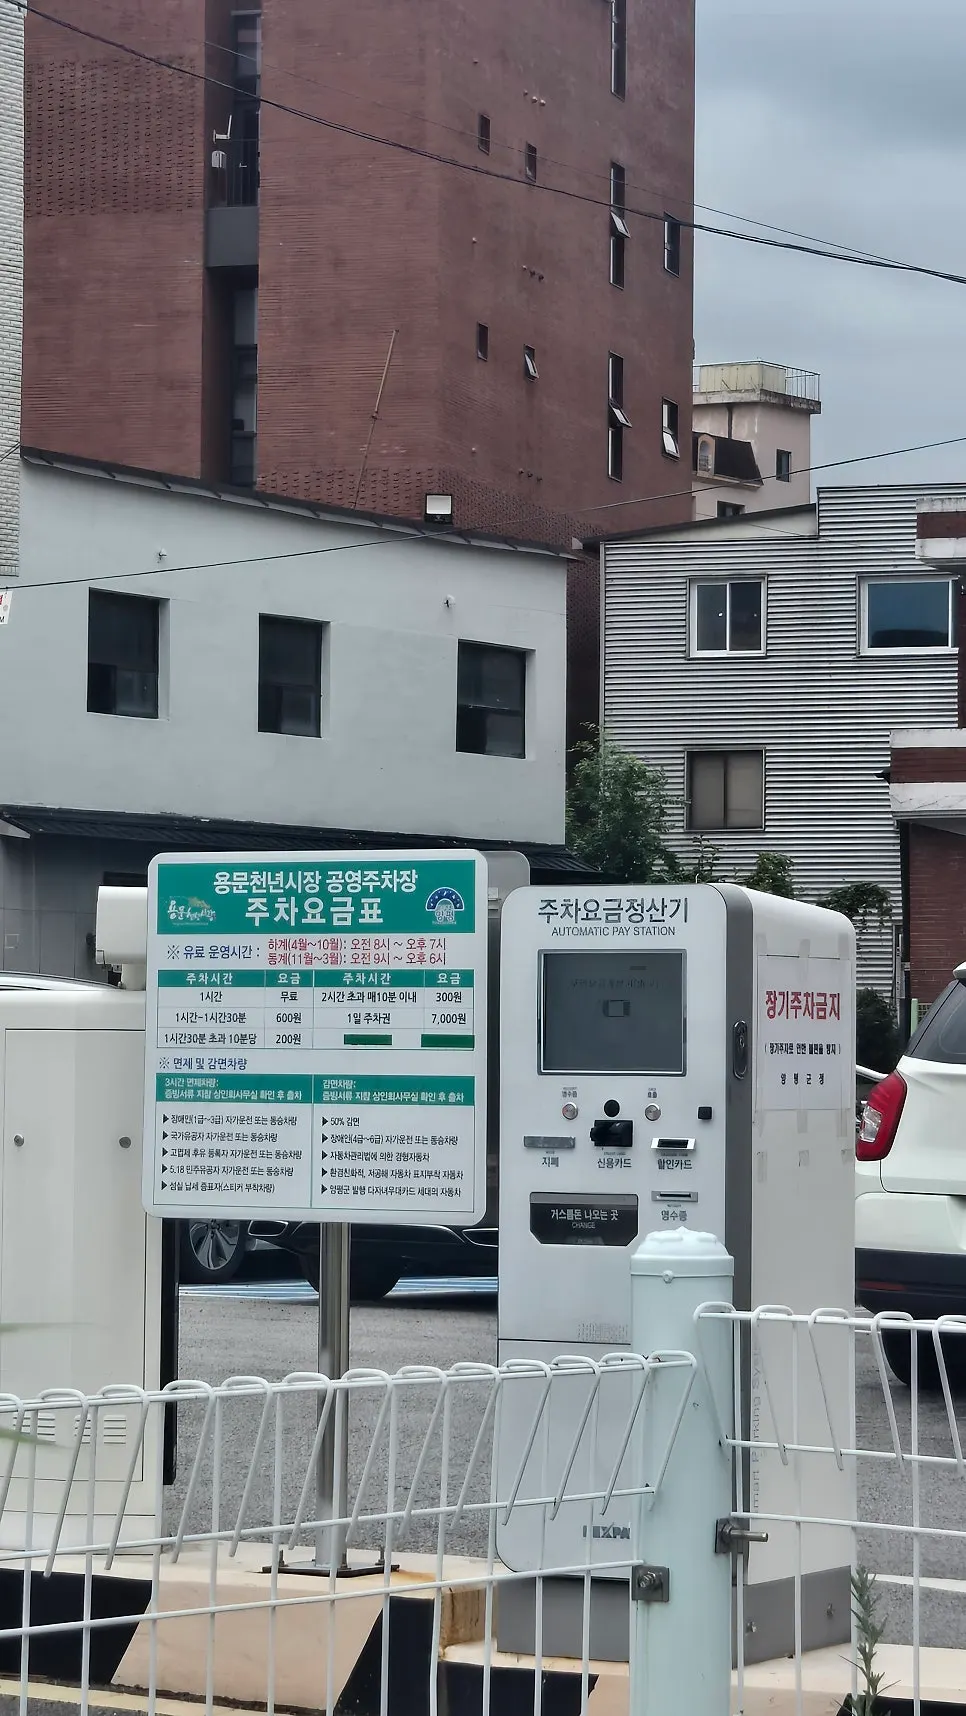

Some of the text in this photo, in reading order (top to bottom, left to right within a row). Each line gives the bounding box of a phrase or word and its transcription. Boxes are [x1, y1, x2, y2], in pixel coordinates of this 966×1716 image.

[214, 870, 418, 894] 용문천년시장 공영주차장
[245, 896, 384, 926] 주차요금표
[538, 897, 688, 924] 주차요금정산기
[552, 926, 676, 936] AUTOMATIC PAY STATION
[268, 938, 347, 951] 하계(4월~10월):
[350, 938, 371, 950] 오전
[374, 938, 390, 950] 8시
[406, 938, 426, 950] 오후
[430, 938, 446, 950] 7시
[184, 945, 206, 960] 유료
[208, 945, 252, 960] 운영시간
[268, 952, 347, 966] 동계(11월~3월):
[350, 953, 371, 964] 오전
[374, 953, 390, 964] 9시
[406, 953, 426, 964] 오후
[430, 953, 446, 964] 6시
[186, 972, 233, 985] 주차시간
[278, 973, 300, 984] 요금
[343, 973, 392, 985] 주차시간
[436, 974, 461, 984] 요금
[200, 991, 222, 1002] 1시간
[280, 992, 298, 1002] 무료
[322, 992, 417, 1002] 2시간 초과 매10분 이내
[436, 992, 462, 1002] 300원
[766, 990, 840, 1020] 장기주차금지
[276, 1012, 302, 1024] 600원
[348, 1013, 391, 1024] 1일 주차권
[432, 1014, 466, 1025] 7,000원
[164, 1033, 257, 1044] 1시간30분 초과 10분당
[276, 1034, 301, 1044] 200원
[770, 1042, 794, 1054] 장기주차로
[826, 1044, 836, 1055] 방지
[174, 1058, 248, 1070] 면제 및 감면차량
[165, 1078, 184, 1087] 3시간
[277, 1090, 284, 1100] 후
[226, 1116, 252, 1124] 자가운전
[254, 1116, 268, 1125] 또는
[270, 1116, 297, 1126] 동승차량
[330, 1117, 360, 1126] 50% 감면
[170, 1132, 278, 1142] 국가유공자 자가운전 또는 동승차량
[386, 1134, 412, 1144] 자가운전
[414, 1136, 428, 1144] 또는
[430, 1136, 458, 1146] 동승차량
[230, 1149, 258, 1158] 자가운전
[258, 1150, 272, 1158] 또는
[330, 1150, 378, 1161] 자동차관리법에
[380, 1151, 394, 1161] 의한
[542, 1156, 560, 1168] 지폐
[597, 1158, 632, 1168] 신용카드
[658, 1159, 692, 1170] 할인카드
[186, 1166, 220, 1174] 민주유공자
[222, 1166, 248, 1175] 자가운전
[250, 1166, 264, 1175] 또는
[266, 1166, 294, 1176] 동승차량
[390, 1169, 412, 1178] 자동차
[442, 1170, 464, 1180] 자동차
[418, 1187, 438, 1196] 세대의
[440, 1187, 461, 1197] 자동차
[550, 1208, 618, 1220] 거스름돈 나오는 곳
[661, 1210, 688, 1222] 영수증
[752, 1396, 760, 1462] Prking
[752, 1470, 760, 1516] mart
